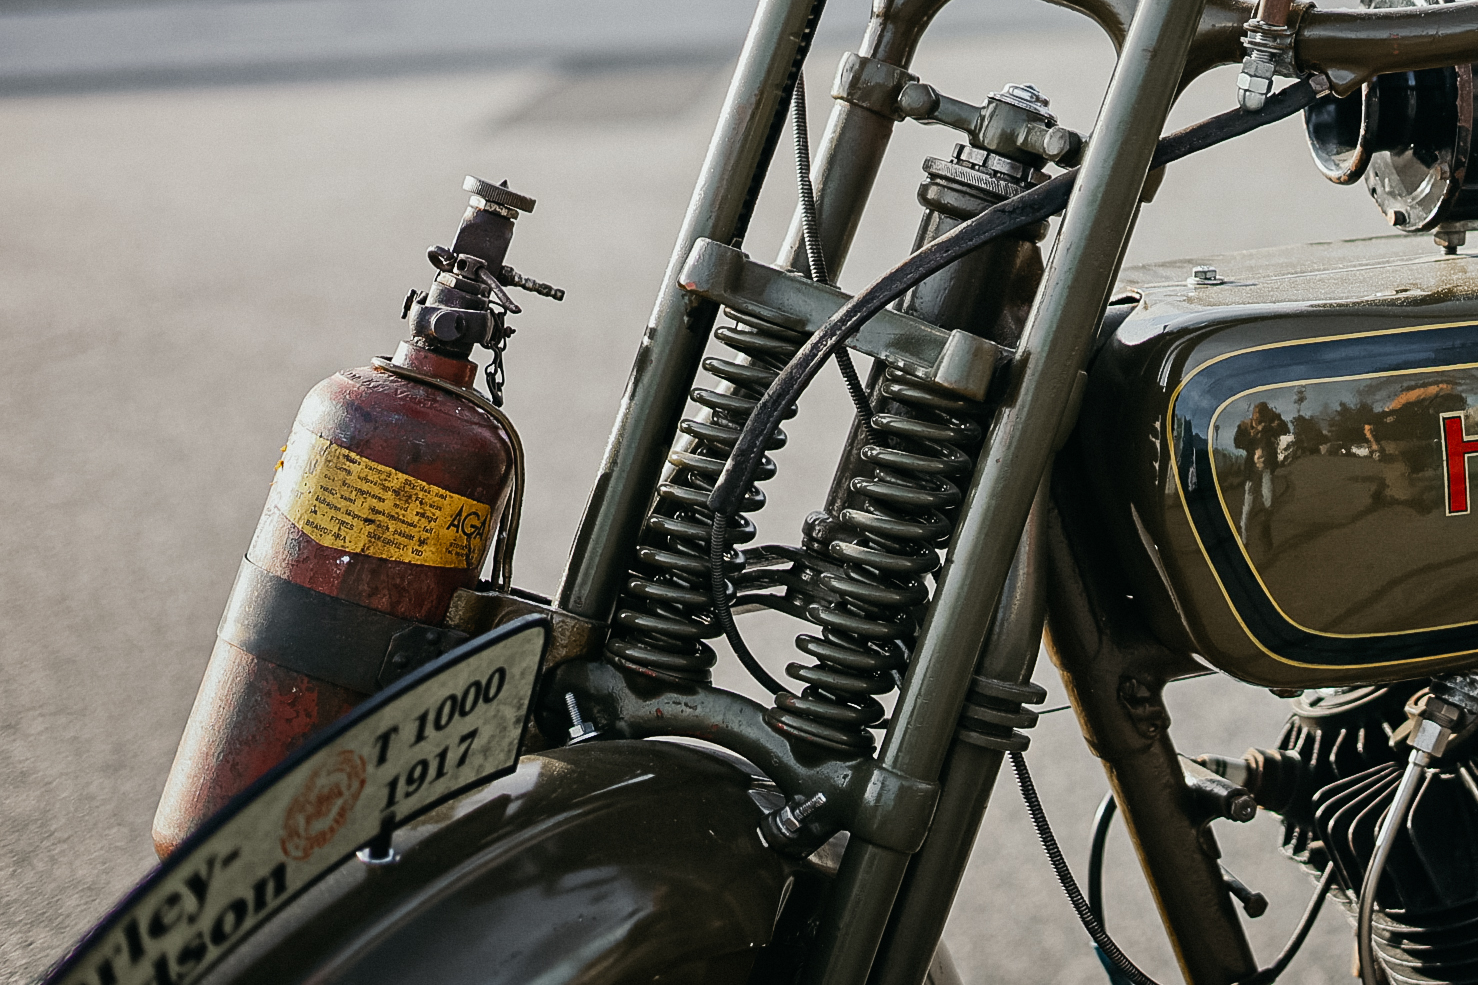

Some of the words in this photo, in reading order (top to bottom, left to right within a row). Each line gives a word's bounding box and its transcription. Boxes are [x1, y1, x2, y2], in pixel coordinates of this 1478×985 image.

[409, 546, 424, 558] VID
[446, 503, 489, 541] AGA
[374, 725, 399, 767] T
[410, 666, 506, 748] 1000
[380, 727, 479, 812] 1917
[78, 847, 241, 985] rley-
